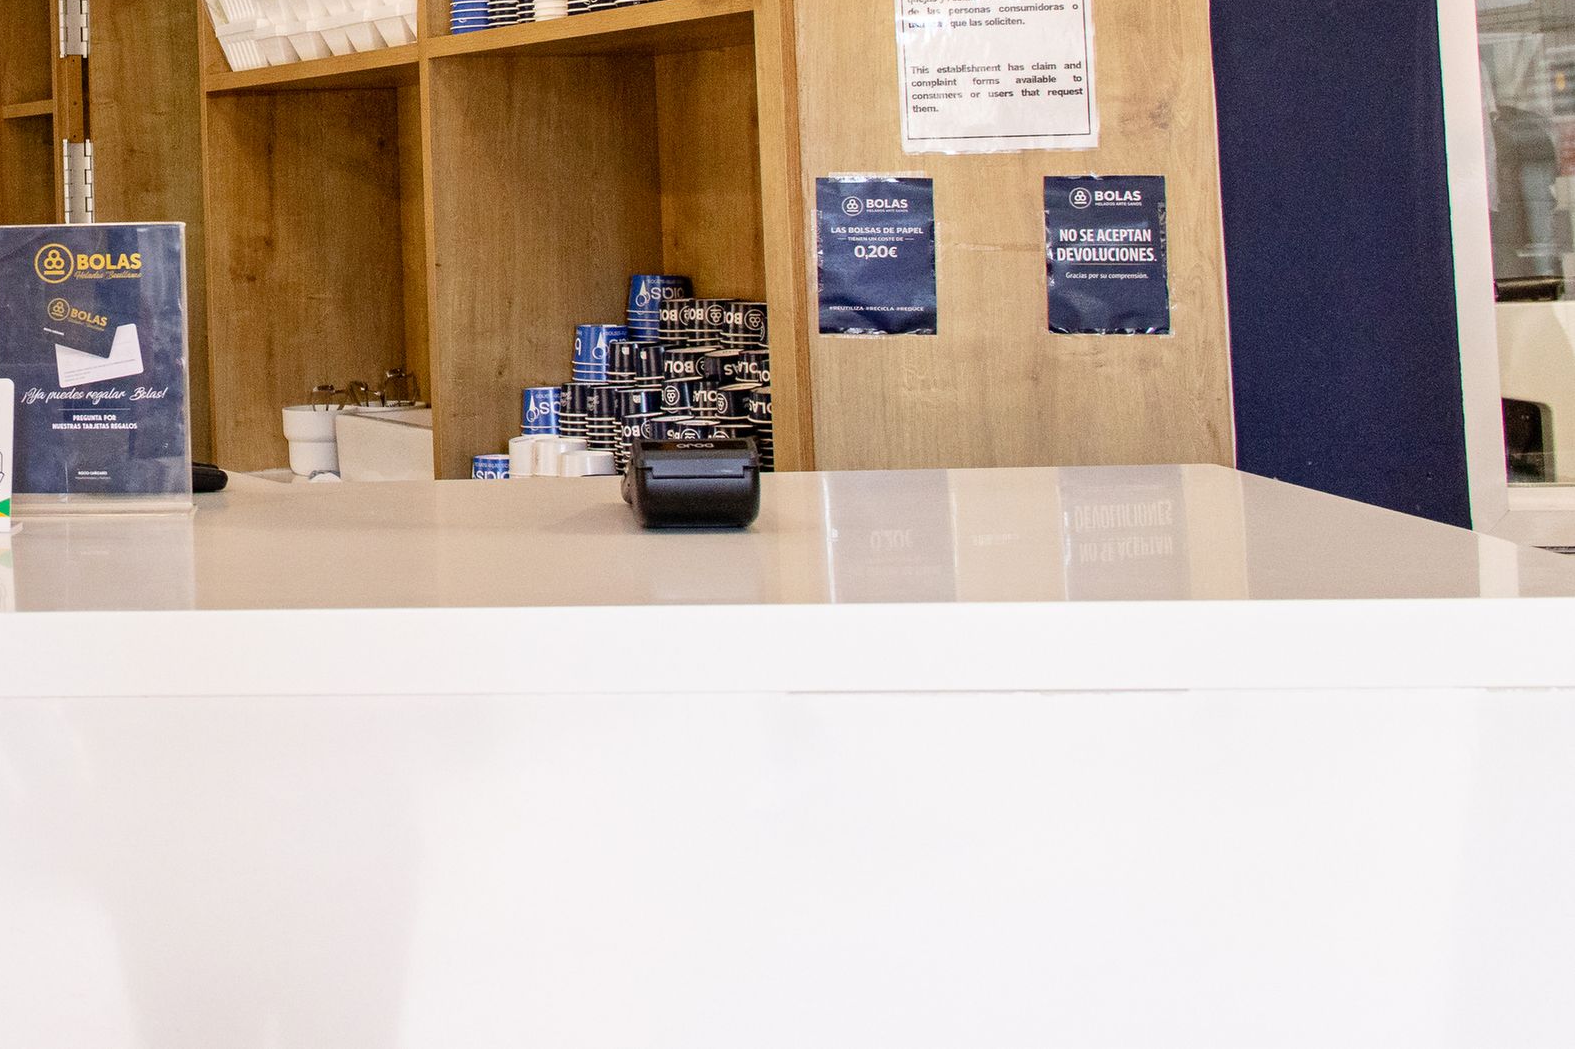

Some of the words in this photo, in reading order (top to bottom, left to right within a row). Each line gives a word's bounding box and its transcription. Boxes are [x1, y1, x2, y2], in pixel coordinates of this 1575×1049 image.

[948, 6, 991, 16] personas
[999, 3, 1065, 13] consumidoras
[950, 21, 967, 29] que
[969, 18, 982, 27] las
[985, 18, 1026, 27] soliciten.
[911, 65, 929, 74] This
[937, 63, 1001, 74] establishment
[1008, 63, 1025, 72] has
[1031, 62, 1057, 71] claim
[1064, 61, 1082, 70] and
[911, 78, 957, 88] complaint
[972, 77, 1000, 86] forms
[1015, 75, 1057, 84] available
[1073, 74, 1082, 82] to
[912, 91, 963, 100] consumers
[1021, 88, 1040, 97] that
[1047, 87, 1083, 97] request
[912, 104, 939, 113] them.
[1095, 190, 1142, 202] BOLAS
[866, 199, 908, 209] BOLAS
[1059, 229, 1077, 242] NO
[1080, 229, 1094, 242] SE
[1096, 228, 1151, 242] ACEPTAN
[854, 245, 898, 260] 0,20€
[1056, 247, 1157, 262] DEVOLUCIONES.
[76, 252, 142, 271] BOLAS
[1108, 272, 1149, 280] comprensión.
[70, 308, 108, 327] BOLAS
[45, 387, 85, 404] puedes
[85, 387, 127, 405] regalar
[129, 386, 169, 401] Bolas!
[72, 414, 102, 422] PREGUNTA
[103, 414, 117, 422] POR
